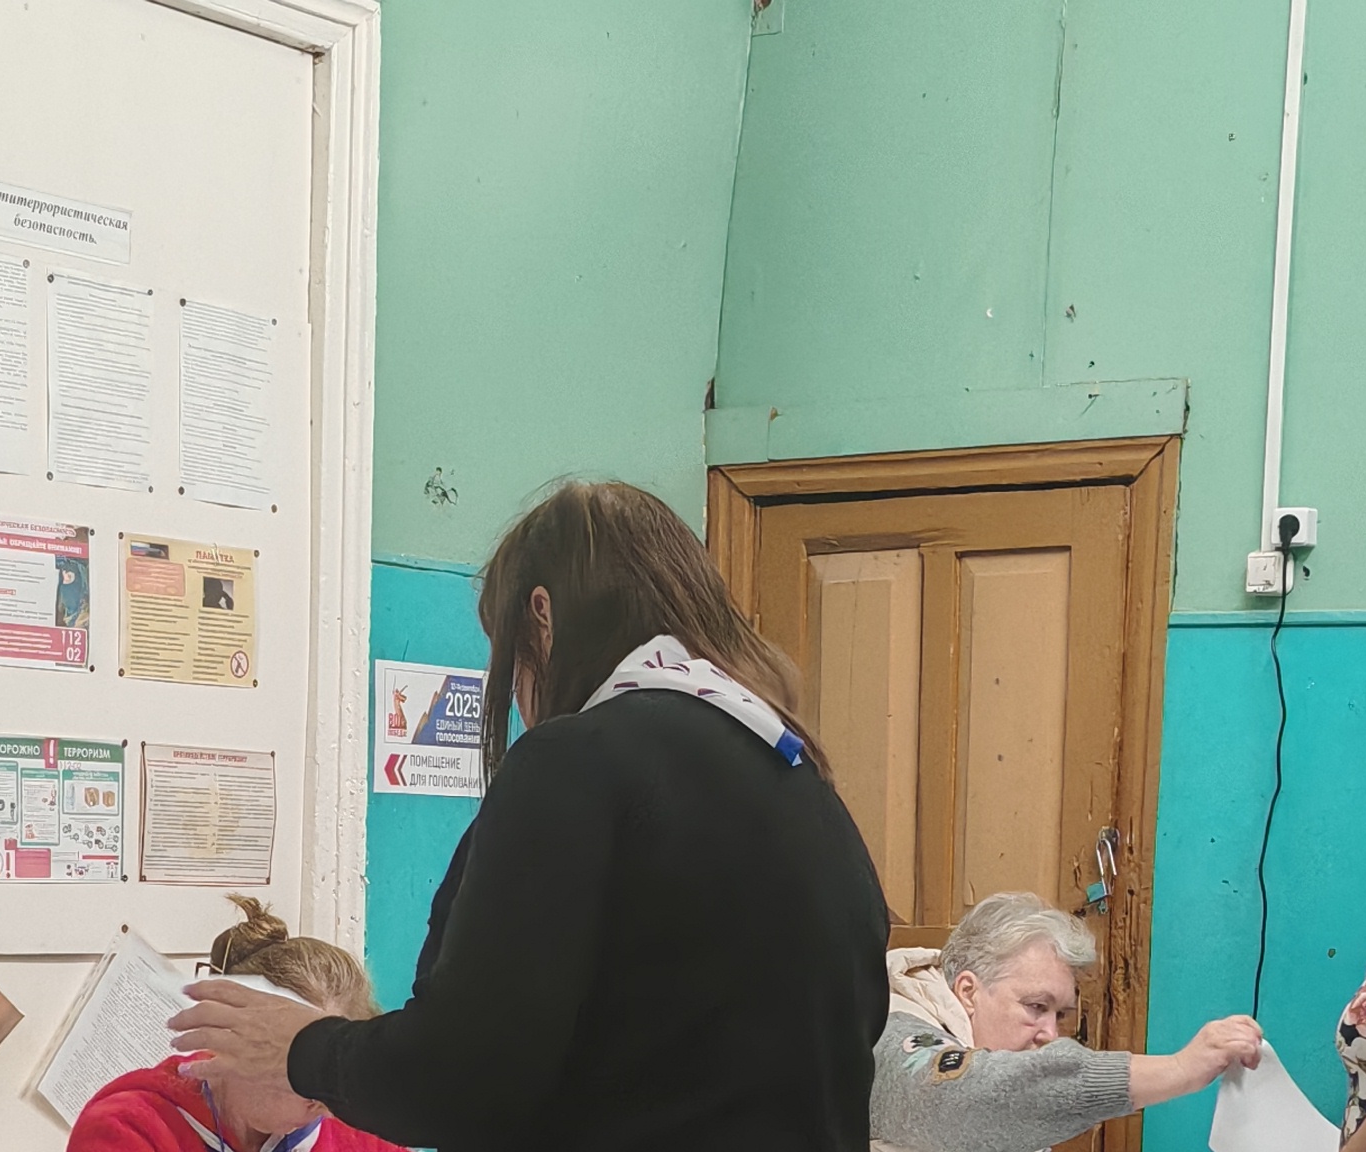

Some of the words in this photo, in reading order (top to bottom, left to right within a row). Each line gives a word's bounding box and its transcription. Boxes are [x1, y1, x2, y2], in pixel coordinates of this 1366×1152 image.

[61, 630, 82, 646] 112
[66, 646, 82, 661] 02
[445, 691, 481, 718] 2025
[436, 719, 463, 732] ЕДИНЫЙ
[63, 747, 111, 759] ТЕРРОРИЗМ
[409, 754, 461, 770] ПОМЕЩЕНИЕ
[409, 774, 427, 787] ДЛЯ
